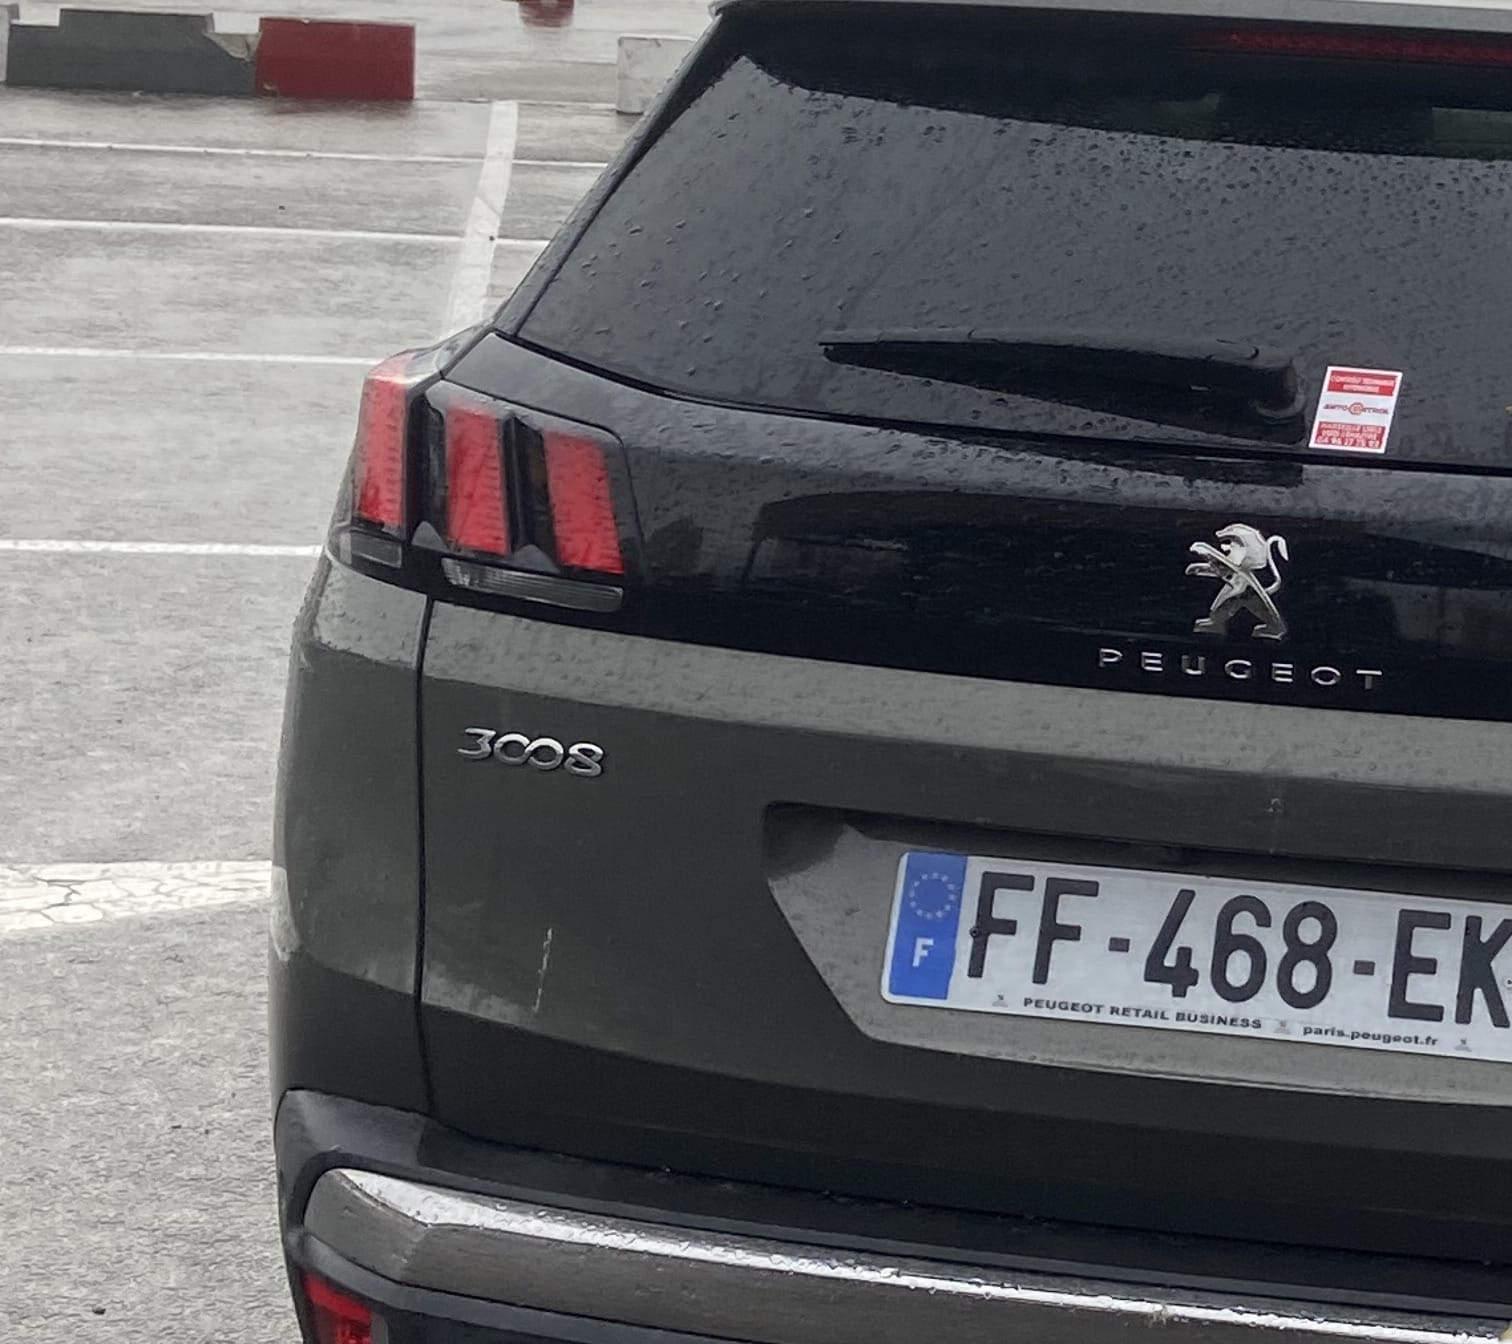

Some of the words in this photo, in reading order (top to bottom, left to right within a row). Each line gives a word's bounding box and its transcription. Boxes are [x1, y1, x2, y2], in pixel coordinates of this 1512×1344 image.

[1099, 648, 1383, 689] PEUGEOT
[457, 727, 604, 777] 3008
[912, 937, 934, 968] F
[1023, 996, 1103, 1014] PEUGEOT
[1109, 1005, 1170, 1021] RETAIL
[1174, 1011, 1262, 1030] BUSINESS
[1302, 1024, 1438, 1047] paris.peugeot.fr
